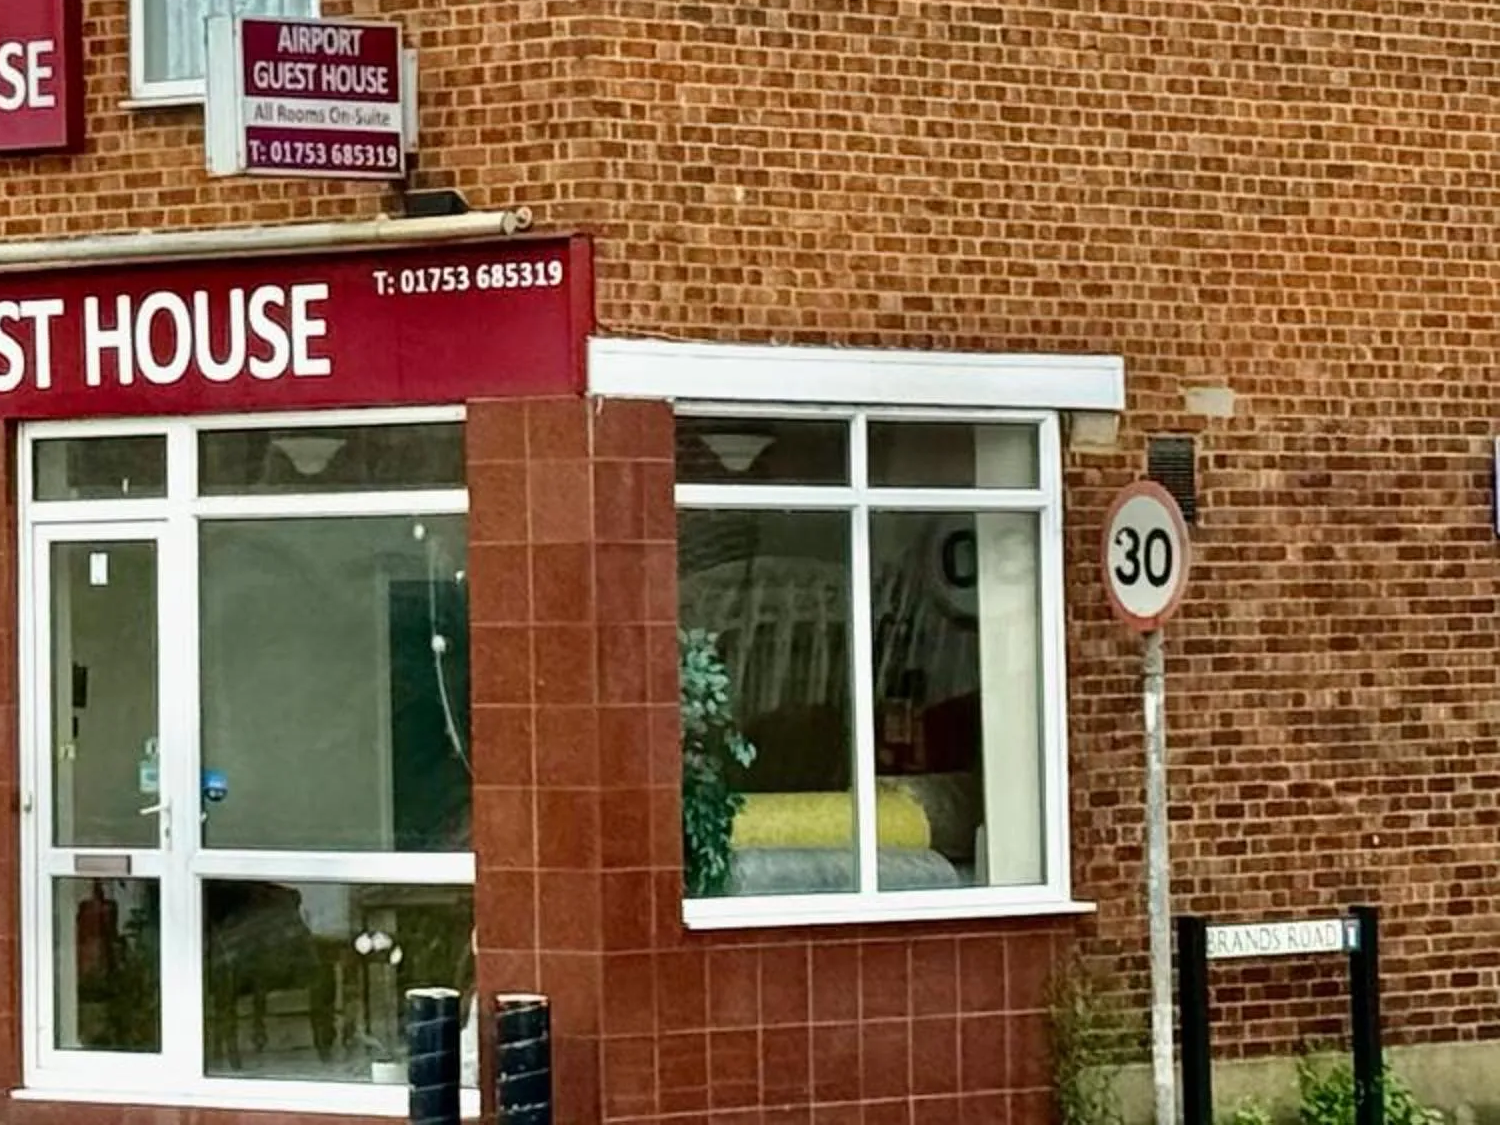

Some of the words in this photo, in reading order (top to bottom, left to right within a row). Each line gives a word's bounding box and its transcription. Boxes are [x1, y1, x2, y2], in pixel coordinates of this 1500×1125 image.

[277, 25, 364, 56] AIRPORT
[253, 61, 317, 91] GUEST
[321, 64, 389, 94] HOUSE
[254, 103, 273, 121] All
[277, 105, 325, 124] Rooms
[249, 139, 267, 163] T:
[270, 140, 327, 165] 01753
[331, 143, 398, 167] 685319
[373, 271, 395, 295] T:
[401, 265, 470, 293] 01753
[476, 260, 563, 289] 685319
[84, 283, 332, 386] HOUSE
[1114, 526, 1173, 588] 30
[1288, 923, 1337, 949] ROAD
